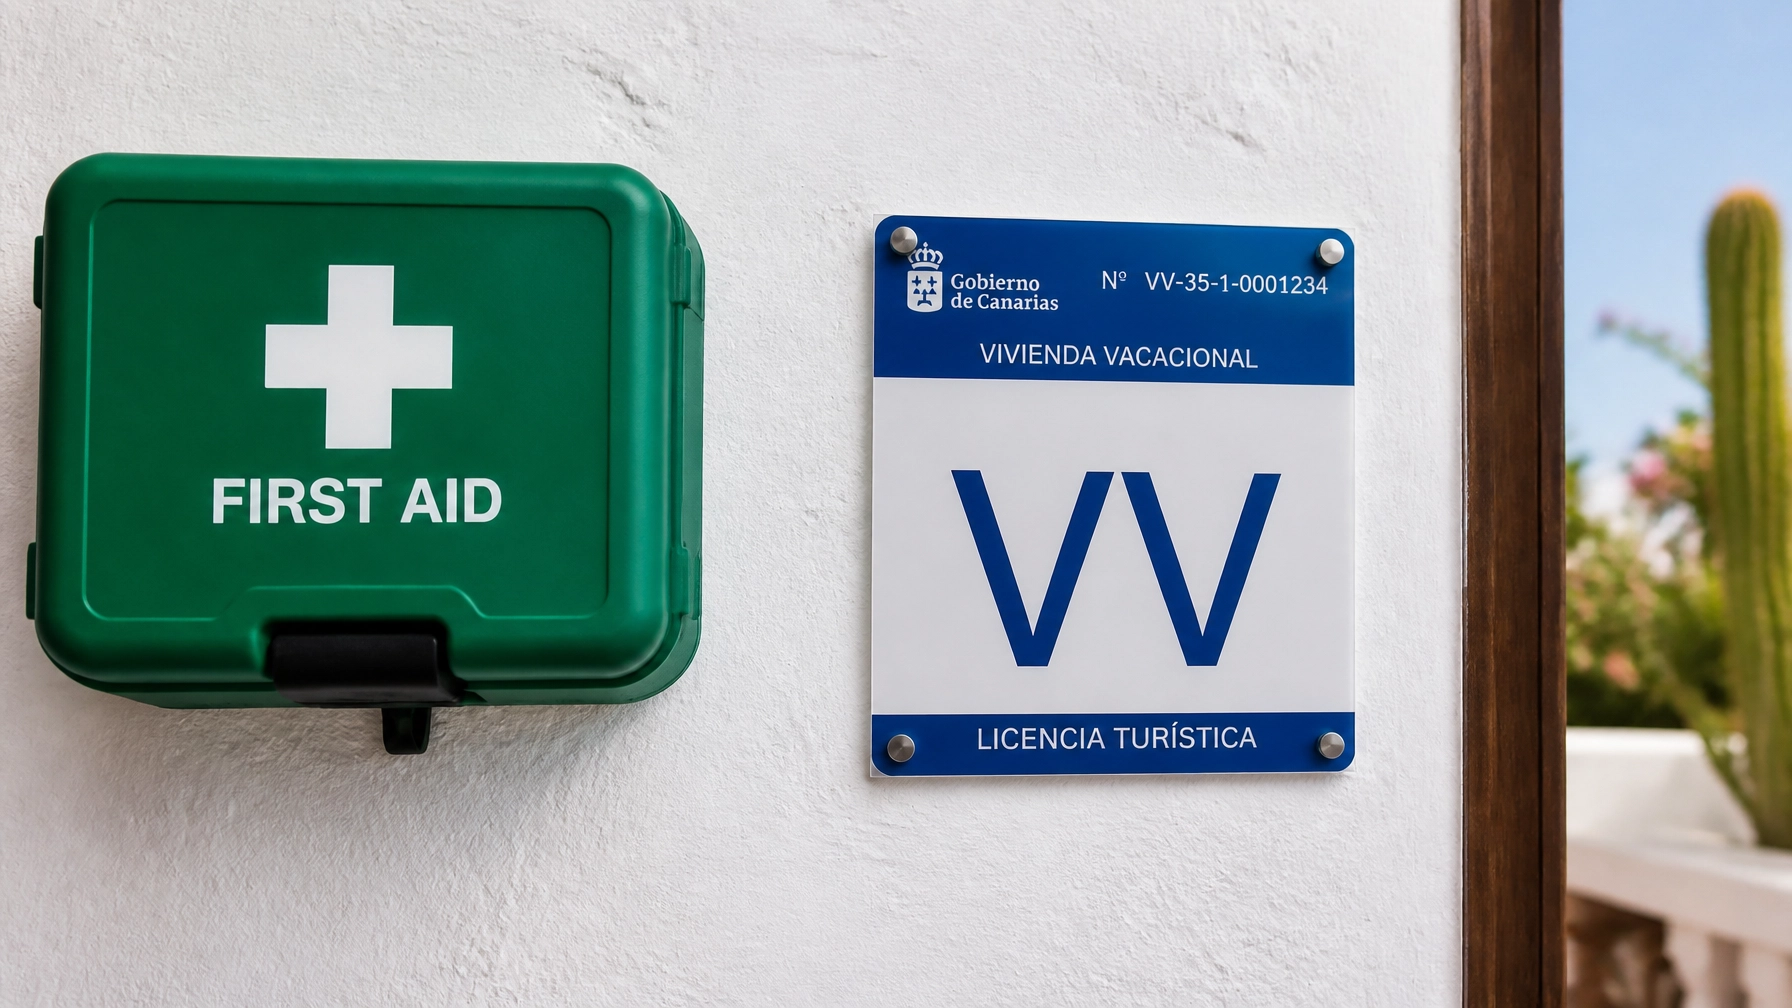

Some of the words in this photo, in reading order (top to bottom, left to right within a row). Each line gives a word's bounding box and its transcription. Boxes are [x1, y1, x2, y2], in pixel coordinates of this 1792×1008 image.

[950, 273, 1040, 291] Gobierno
[1144, 271, 1329, 295] VV-35-1-0001234
[950, 292, 973, 309] de
[977, 293, 1059, 311] Canarias
[979, 343, 1097, 365] VIVIENDA
[1103, 345, 1258, 369] VACACIONAL
[212, 477, 383, 525] FIRST
[400, 477, 502, 523] AID
[951, 470, 1281, 667] VV
[977, 727, 1106, 750] LICENCIA
[1113, 721, 1257, 749] TURÍSTICA
